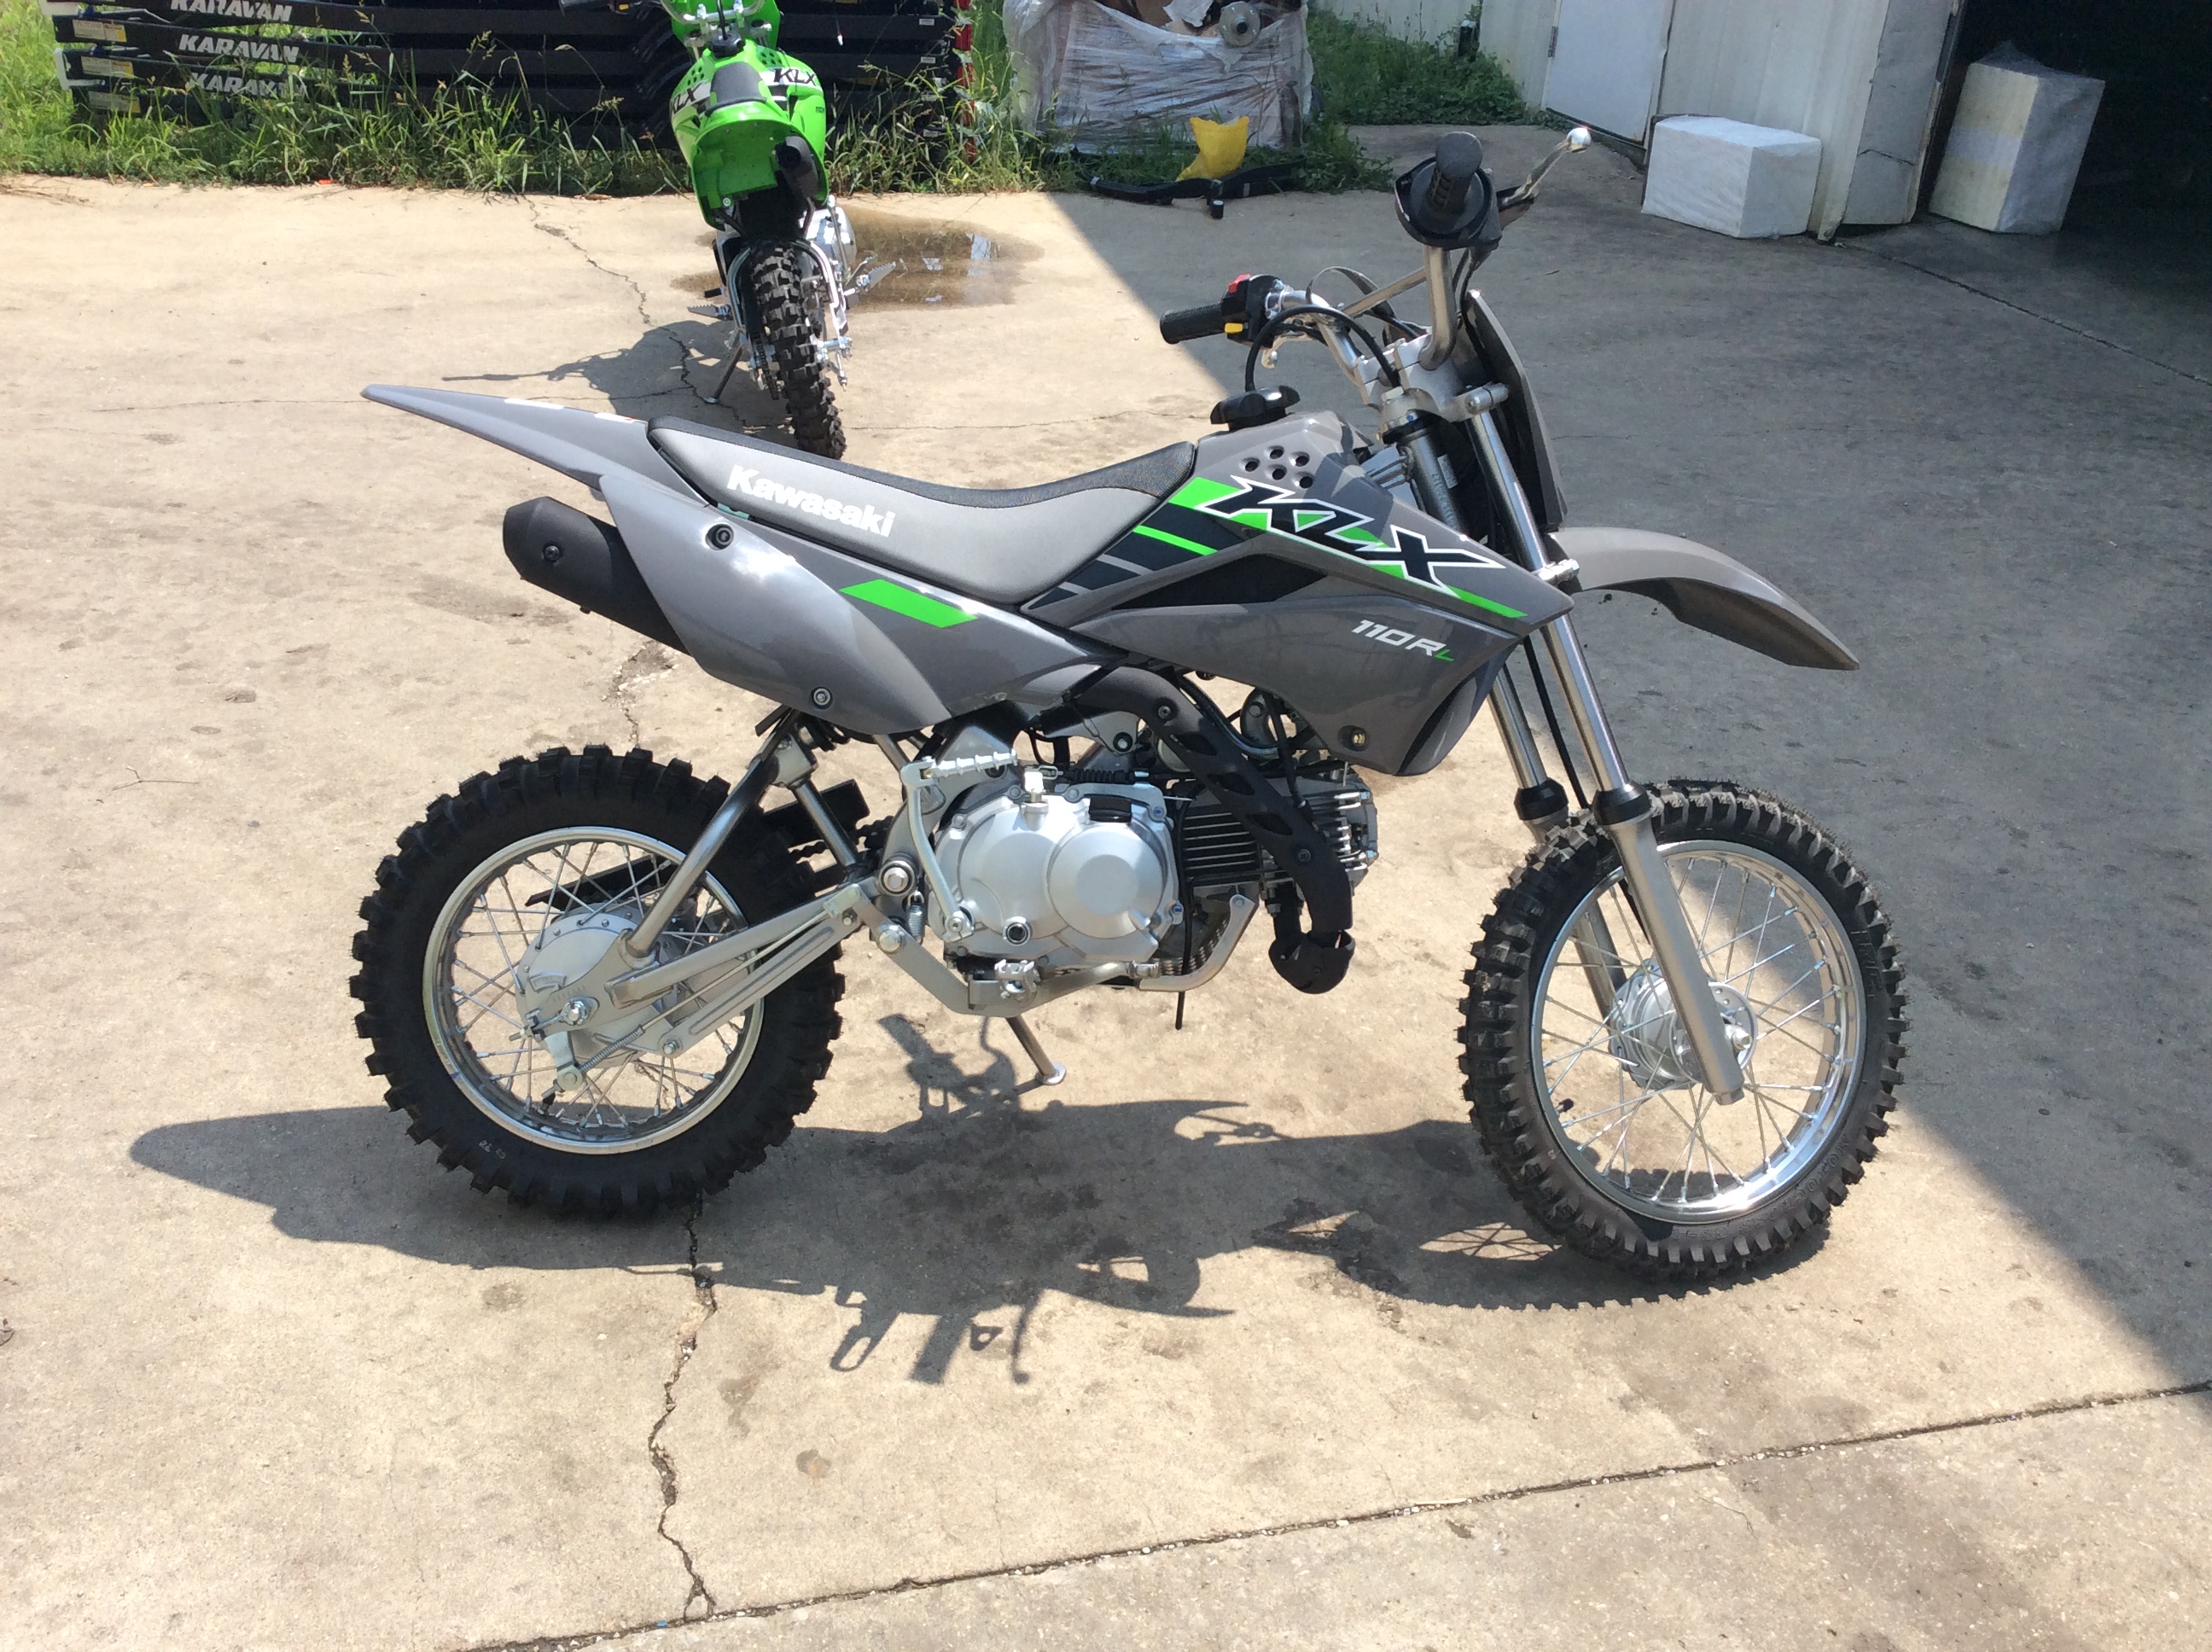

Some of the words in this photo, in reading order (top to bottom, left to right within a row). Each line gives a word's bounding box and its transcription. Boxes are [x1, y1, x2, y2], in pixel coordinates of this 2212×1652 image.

[171, 0, 293, 22] KARAVAN
[178, 33, 300, 63] KARAVAN
[773, 68, 817, 86] KLX
[726, 464, 896, 538] Kawasaki
[1195, 475, 1506, 598] KLX
